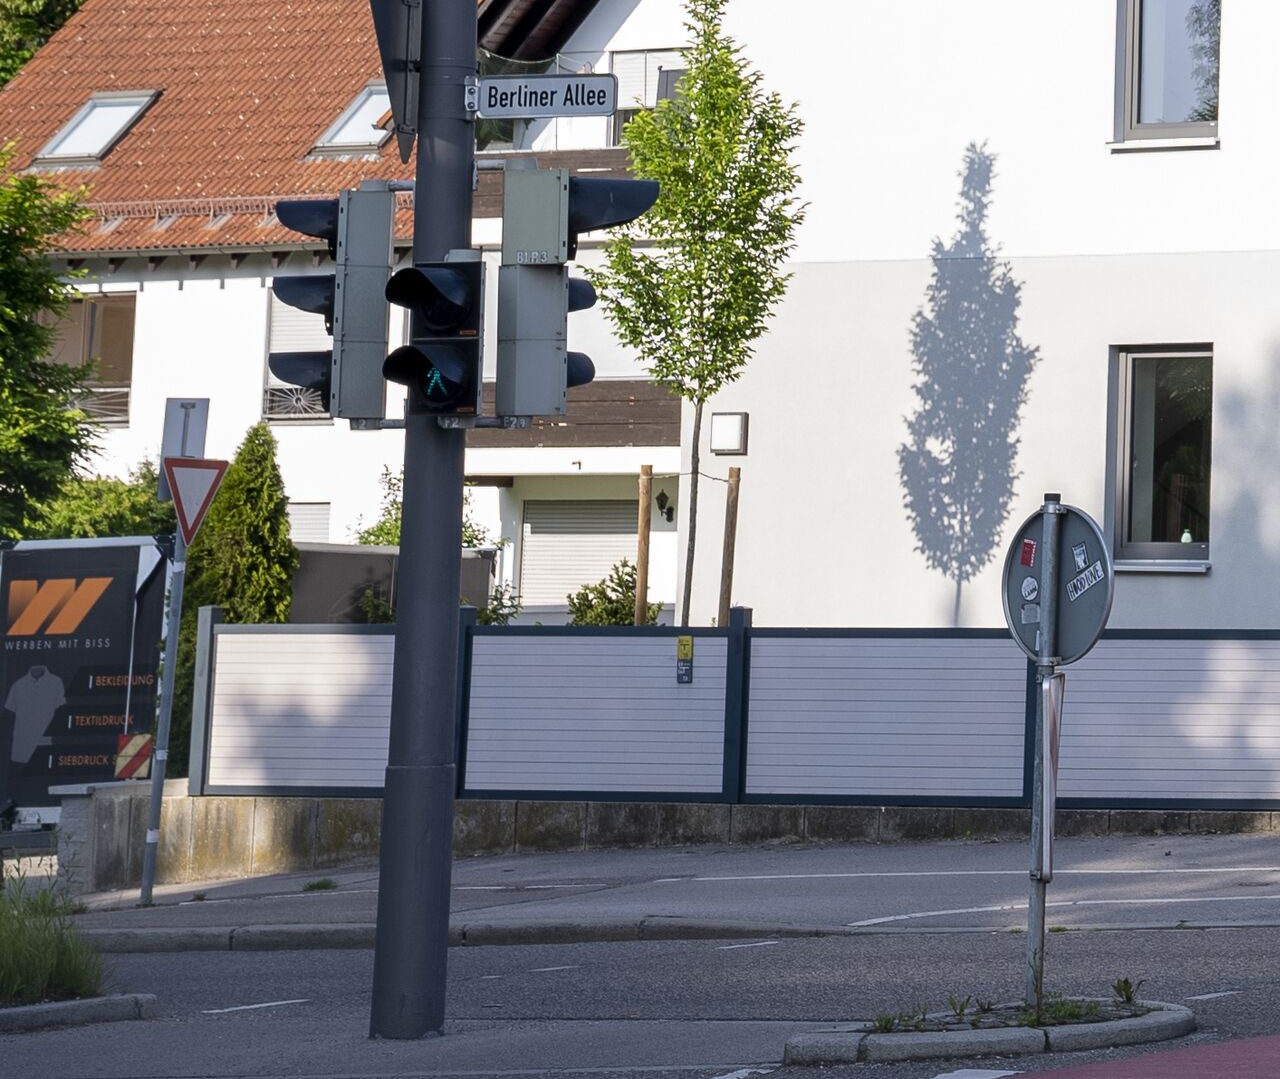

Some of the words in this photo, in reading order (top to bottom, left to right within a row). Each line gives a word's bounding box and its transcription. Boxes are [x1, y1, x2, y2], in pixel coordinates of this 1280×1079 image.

[488, 85, 558, 108] Berliner
[563, 83, 606, 107] Allee
[5, 640, 51, 651] WERBEN
[58, 639, 79, 649] MIT
[85, 638, 111, 649] BISS
[95, 674, 154, 686] BEKLEIDUNG
[75, 714, 134, 726] TEXTILDRUCK
[58, 754, 109, 766] SIEBDRUCK
